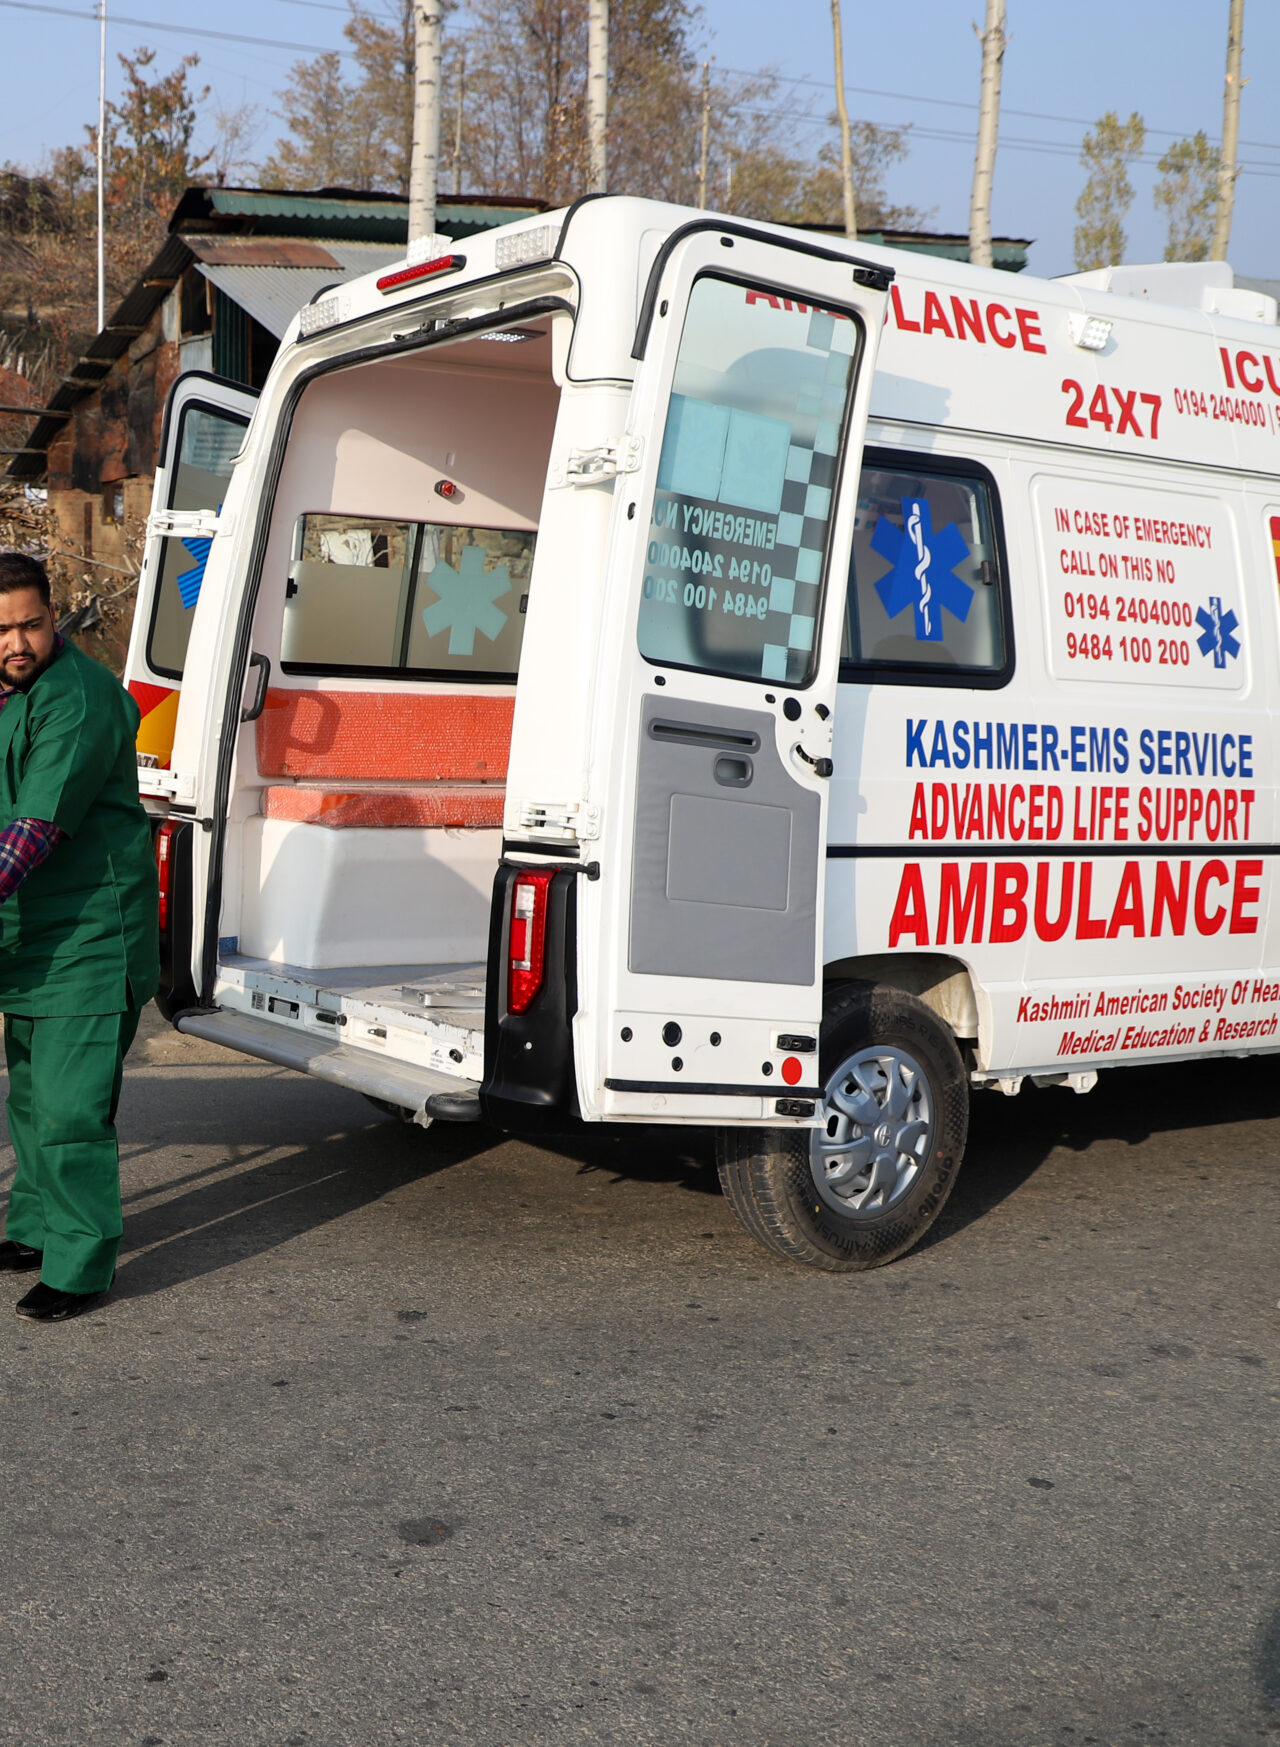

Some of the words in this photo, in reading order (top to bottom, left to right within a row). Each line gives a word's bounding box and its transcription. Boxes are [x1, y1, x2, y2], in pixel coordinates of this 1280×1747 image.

[1061, 378, 1162, 440] 24X7
[1174, 387, 1208, 418] 0194
[1210, 393, 1266, 428] 2404000
[1055, 507, 1070, 533] IN
[1074, 509, 1110, 537] CASE
[1113, 514, 1130, 539] OF
[1133, 516, 1212, 549] EMERGENCY
[1060, 548, 1095, 576] CALL
[1099, 552, 1119, 578] ON
[1121, 555, 1153, 582] THIS
[1156, 558, 1175, 584] NO
[1064, 591, 1110, 621] 0194
[1115, 596, 1193, 627] 2404000
[1066, 632, 1113, 661] 9484
[1119, 636, 1152, 663] 100
[1158, 639, 1190, 666] 200
[906, 718, 1129, 774] KASHMER-EMS
[1139, 728, 1253, 778] SERVICE
[908, 781, 1064, 841] ADVANCED
[1073, 785, 1130, 841] LIFE
[1137, 786, 1255, 842] SUPPORT
[888, 858, 1263, 948] AMBULANCE
[1016, 992, 1092, 1023] Kashmiri
[1093, 989, 1168, 1017] American
[1172, 983, 1228, 1013] Society
[1231, 979, 1250, 1005] Of
[1251, 978, 1280, 1003] Hea
[1057, 1026, 1121, 1057] Medical
[1121, 1021, 1196, 1050] Education
[1198, 1018, 1211, 1043] &
[1213, 1012, 1279, 1042] Research
